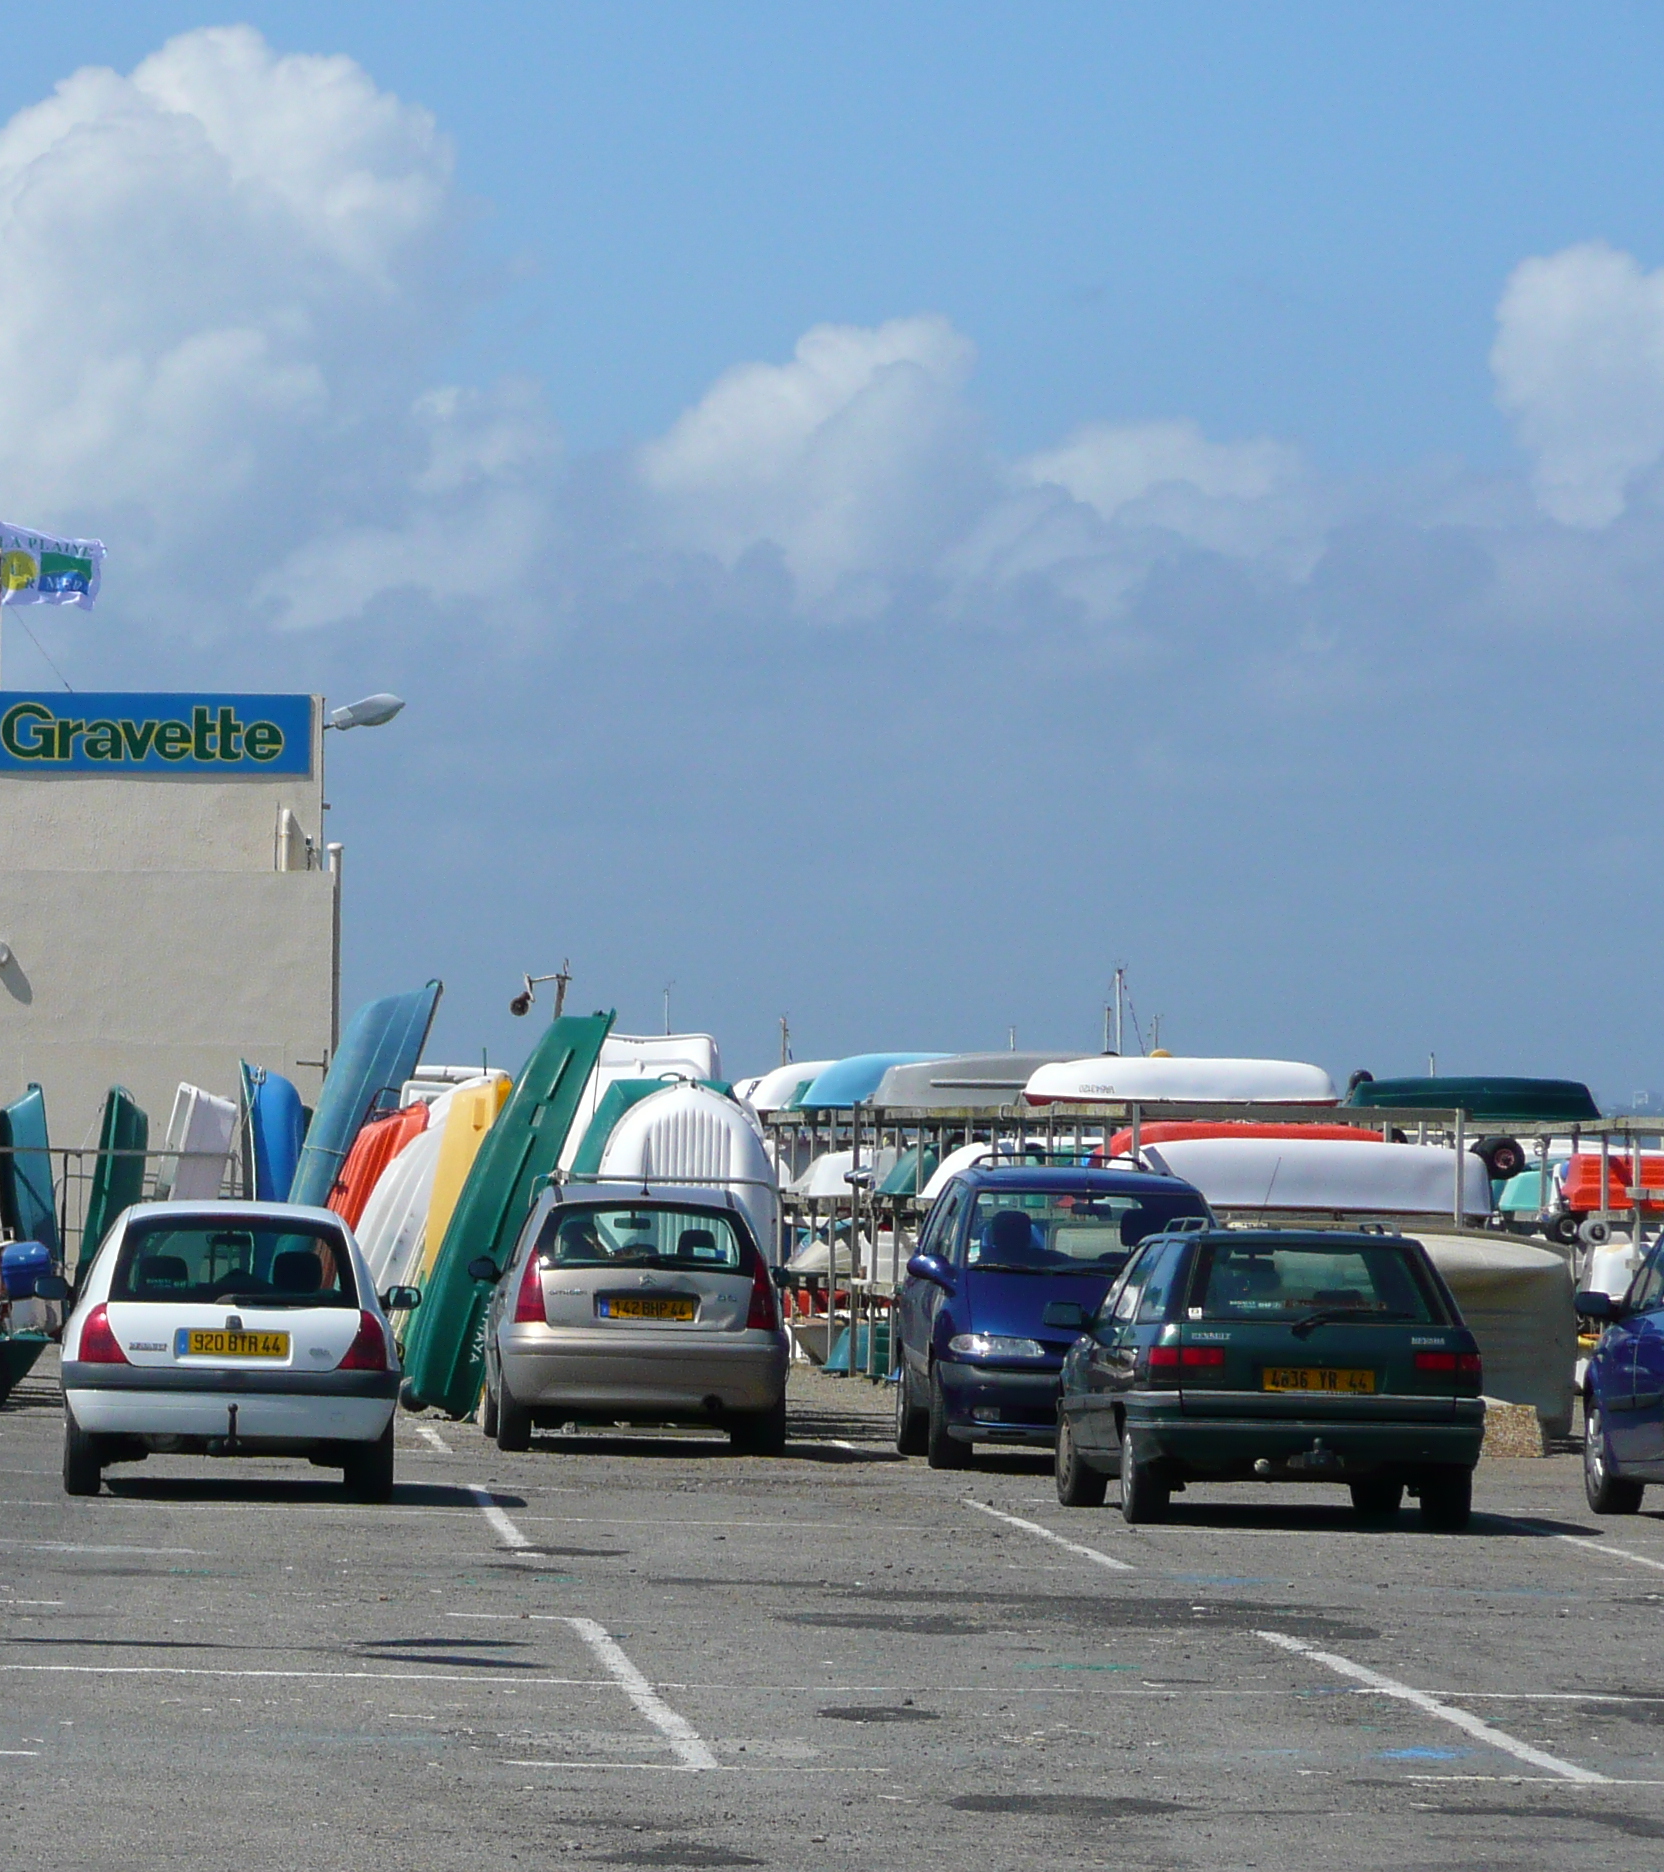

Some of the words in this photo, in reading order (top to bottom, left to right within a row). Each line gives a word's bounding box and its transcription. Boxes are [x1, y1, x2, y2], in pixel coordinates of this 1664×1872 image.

[0, 701, 284, 762] Gravette
[642, 1301, 667, 1317] BHP
[671, 1302, 687, 1316] 44
[193, 1333, 224, 1351] 920
[262, 1336, 282, 1354] 44
[1348, 1372, 1367, 1390] 44
